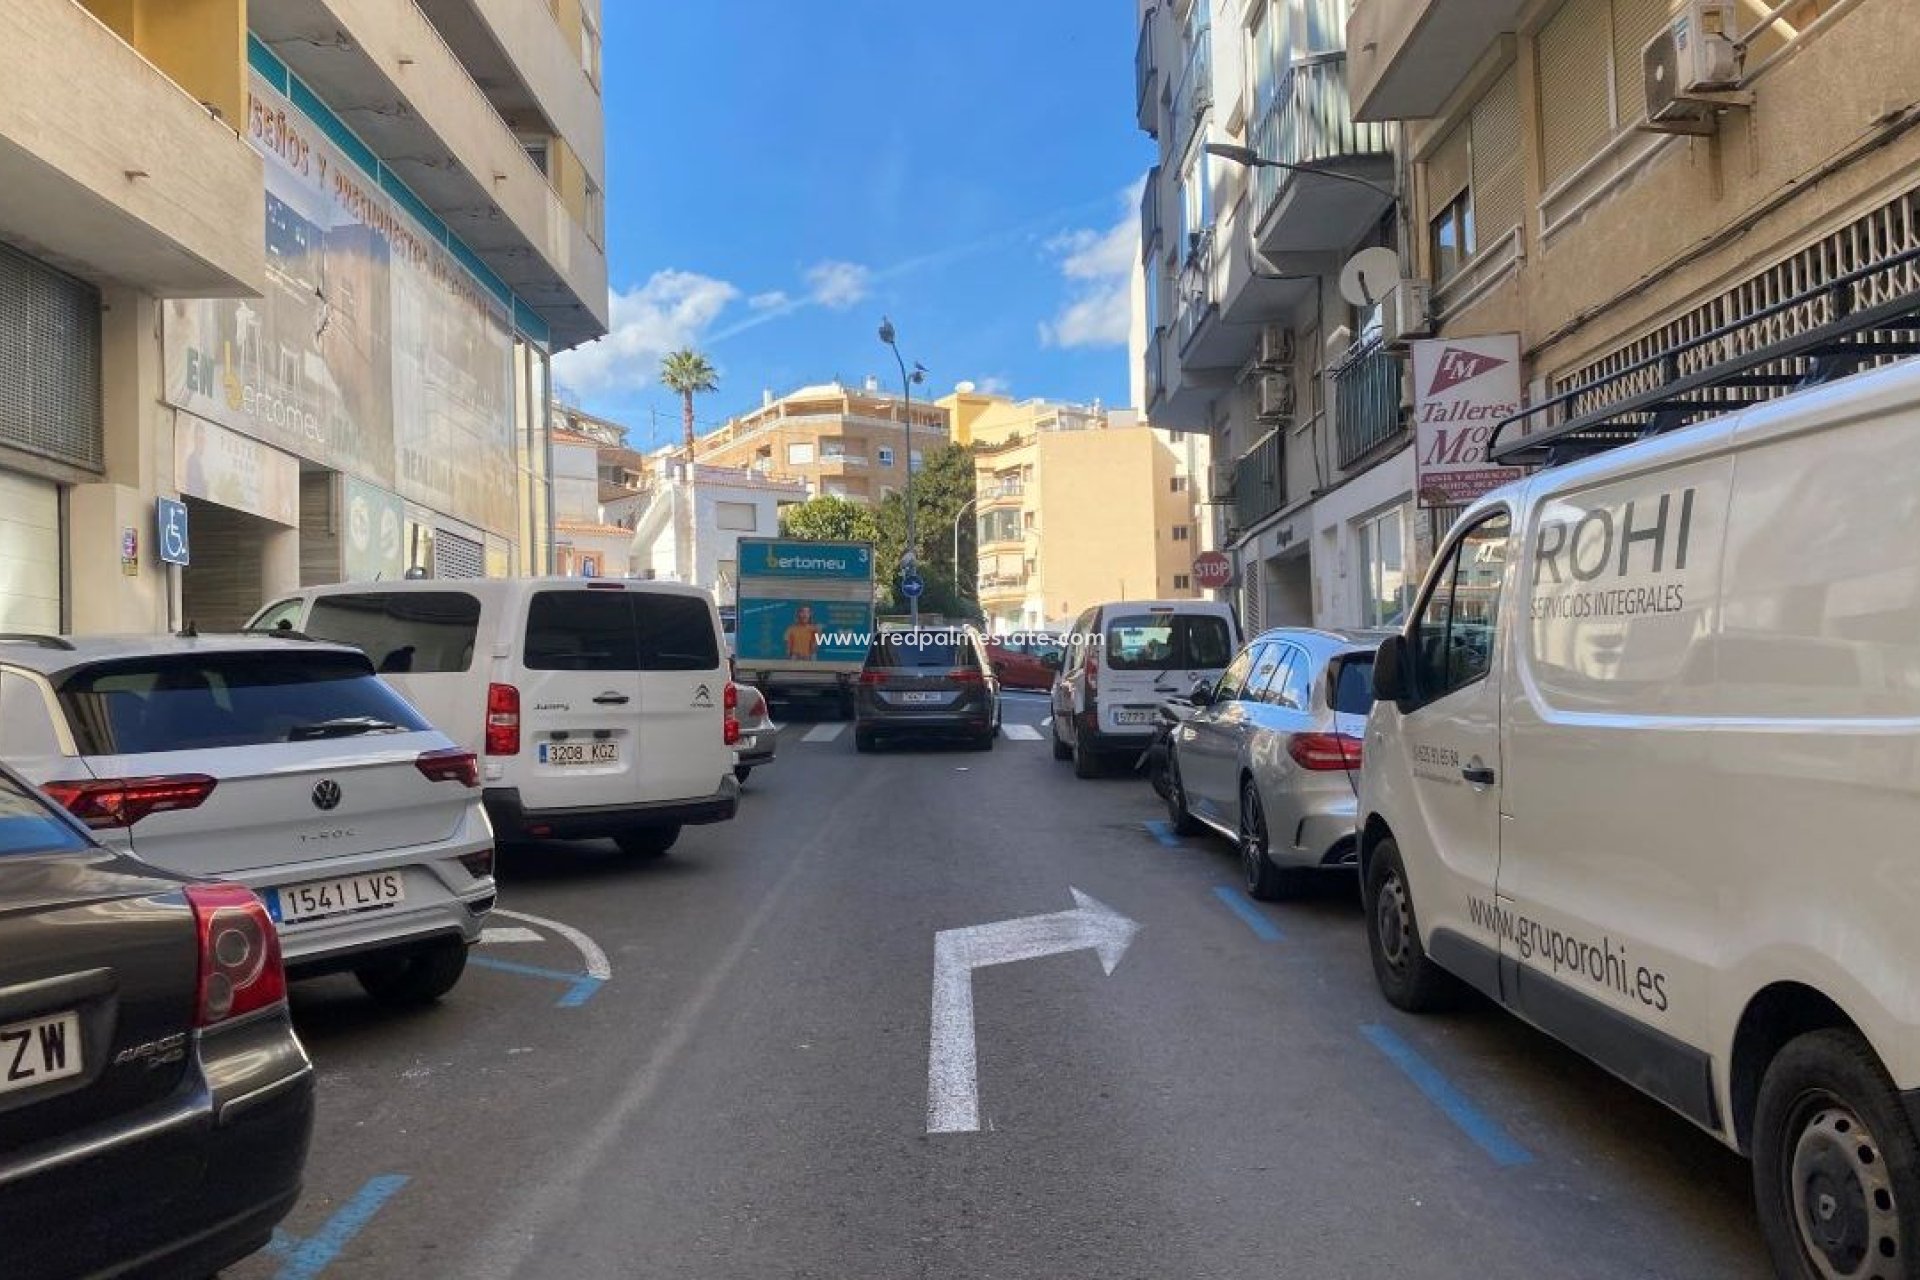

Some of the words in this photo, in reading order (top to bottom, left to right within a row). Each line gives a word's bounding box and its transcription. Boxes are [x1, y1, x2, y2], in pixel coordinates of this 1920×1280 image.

[1421, 400, 1518, 424] Talleres
[1532, 488, 1696, 586] ROHI
[767, 544, 846, 570] bertomeu
[859, 549, 869, 563] 3
[1194, 561, 1228, 577] STOP
[1530, 593, 1592, 620] SERVICIOS
[1595, 585, 1684, 616] INTEGRALES
[551, 745, 583, 761] 3208
[592, 744, 616, 760] KGZ
[288, 883, 345, 915] 1541
[354, 875, 398, 904] LVS
[1467, 895, 1669, 1012] www.gruporohi.es
[0, 1021, 66, 1082] ZW
